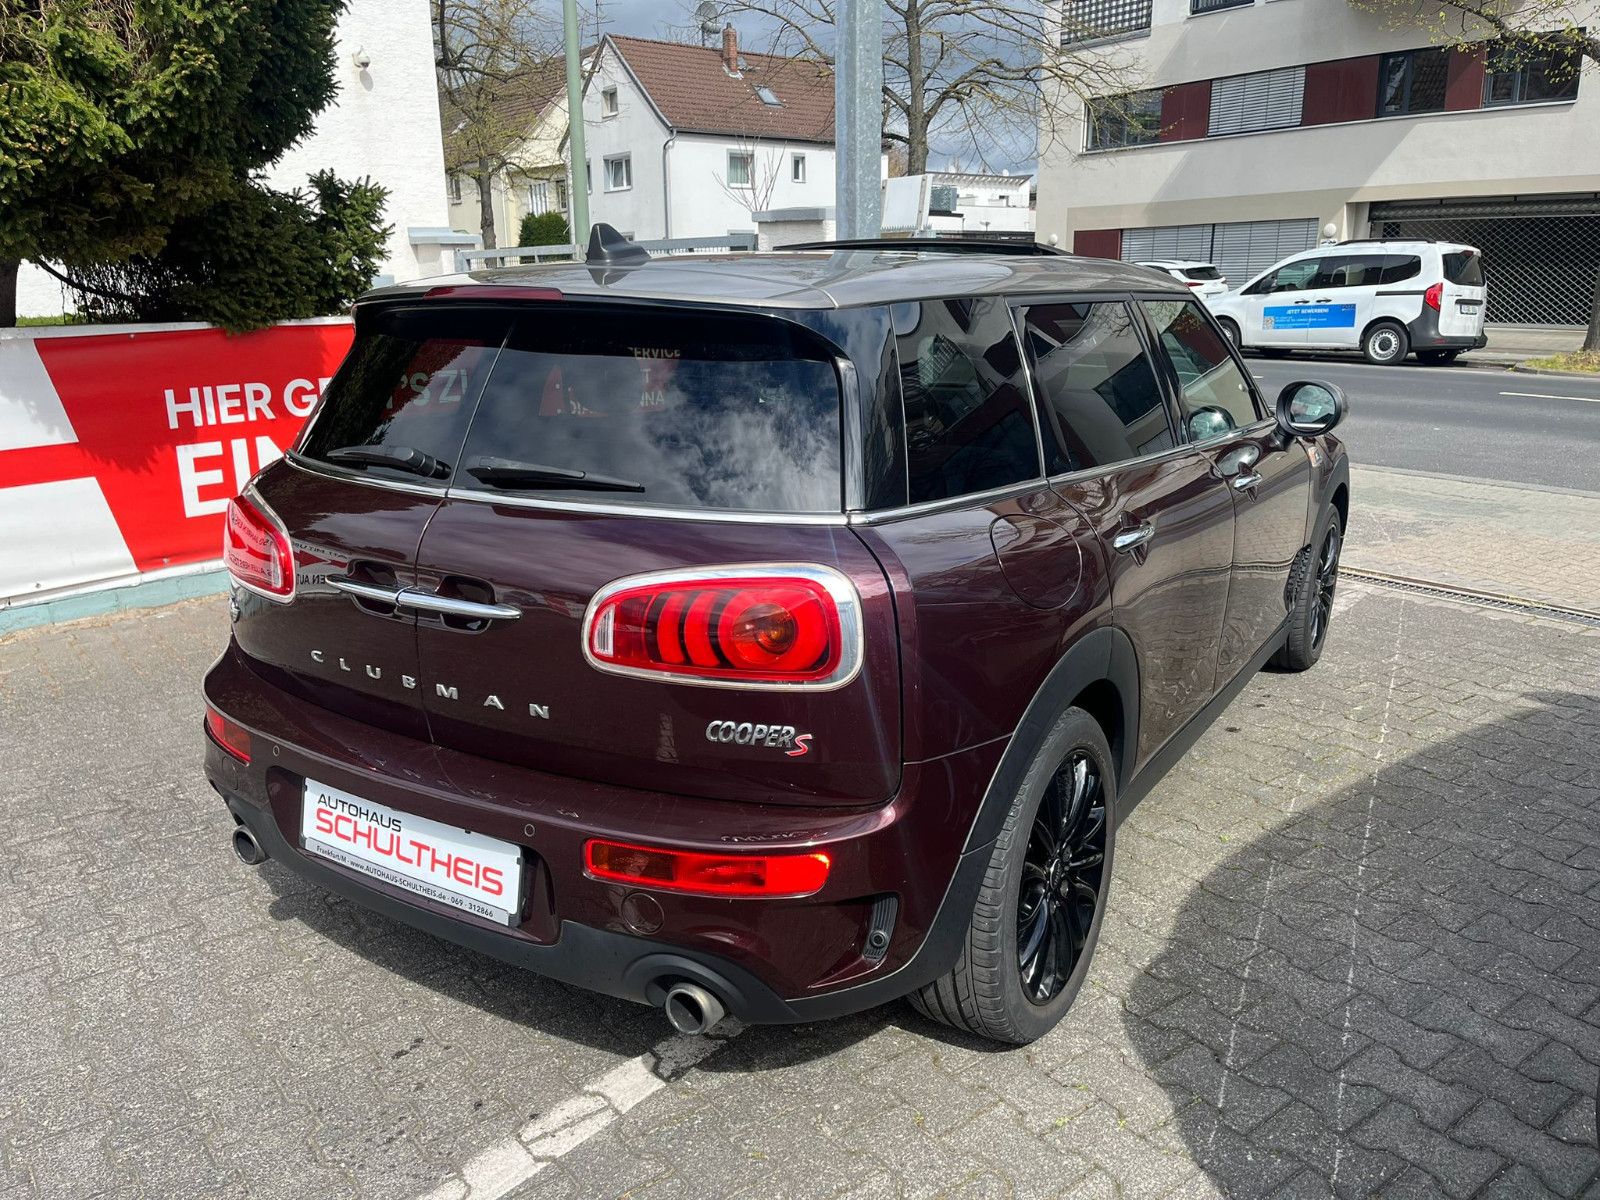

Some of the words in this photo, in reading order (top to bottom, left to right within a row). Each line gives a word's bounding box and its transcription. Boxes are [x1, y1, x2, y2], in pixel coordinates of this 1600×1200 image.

[164, 382, 275, 430] HIER
[309, 647, 551, 722] CLUBMAN
[705, 719, 795, 749] COOPER
[317, 792, 402, 833] AUTOHAUS
[315, 807, 504, 896] SCHULTHEIS
[350, 859, 447, 901] www.AUTOHAUS-SCHULTHEIS.de
[450, 896, 464, 907] 069
[468, 902, 494, 918] 312866
